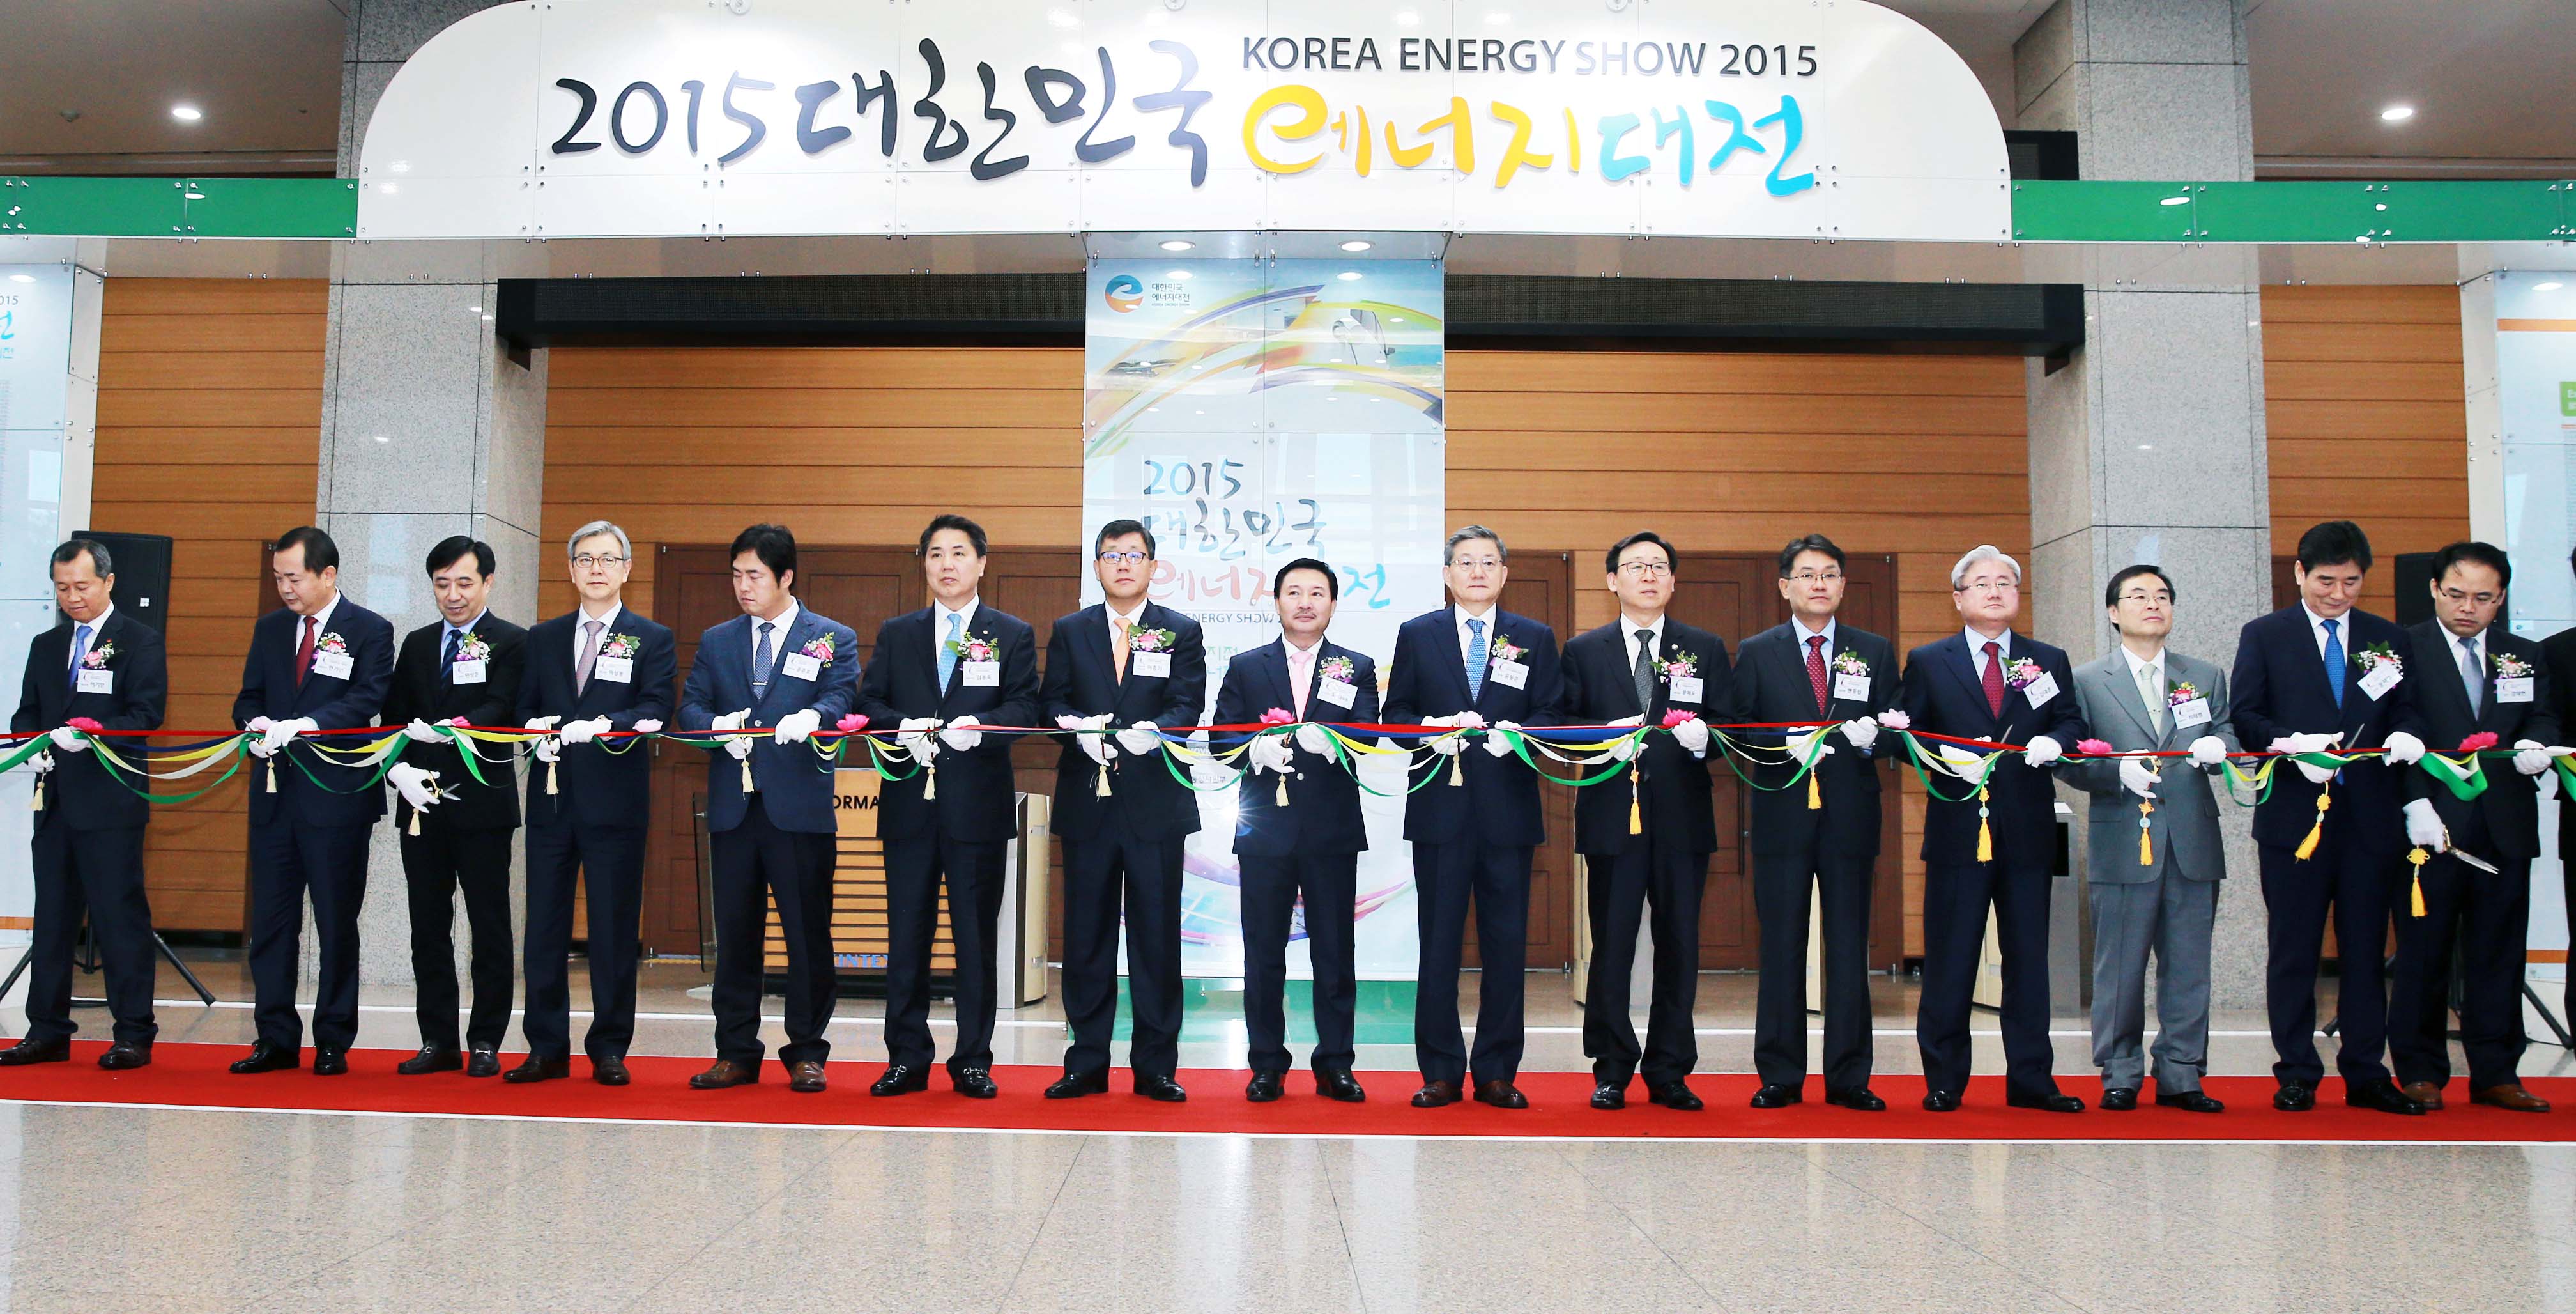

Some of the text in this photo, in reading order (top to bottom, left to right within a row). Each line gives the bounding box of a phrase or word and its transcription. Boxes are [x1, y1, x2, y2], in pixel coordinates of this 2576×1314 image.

[1243, 36, 1818, 77] KOREA ENERGY SHOW 2015
[552, 38, 1213, 187] 2015 대한민국
[1242, 84, 1814, 197] 에너지대전
[1144, 458, 1244, 499] 2015
[1142, 497, 1327, 560] 대한민국
[1147, 560, 1390, 609] 에너지전
[1237, 613, 1274, 623] SHOW
